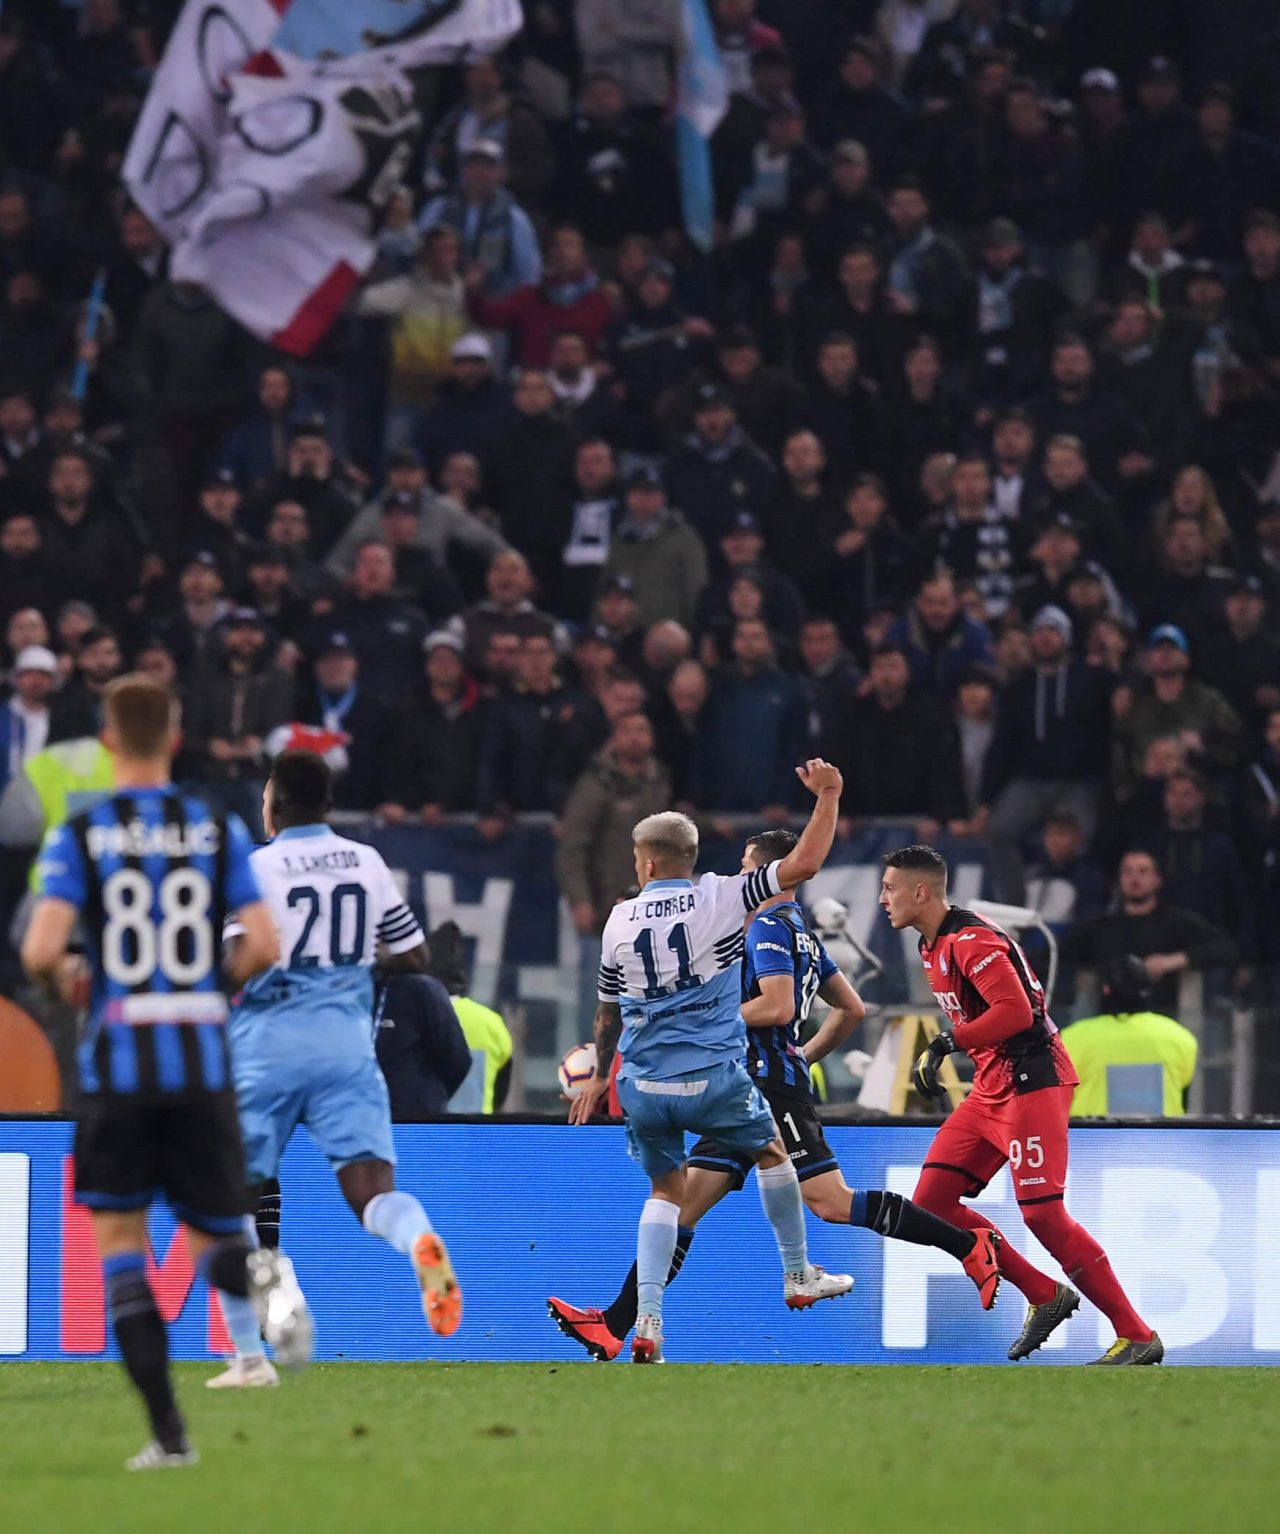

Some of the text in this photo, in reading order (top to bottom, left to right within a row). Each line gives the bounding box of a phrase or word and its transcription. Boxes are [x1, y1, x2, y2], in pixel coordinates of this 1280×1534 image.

[102, 867, 214, 986] 88
[287, 883, 367, 968] 20
[629, 893, 696, 922] J. CORREA
[633, 922, 705, 1001] 11
[1009, 1135, 1044, 1170] 95
